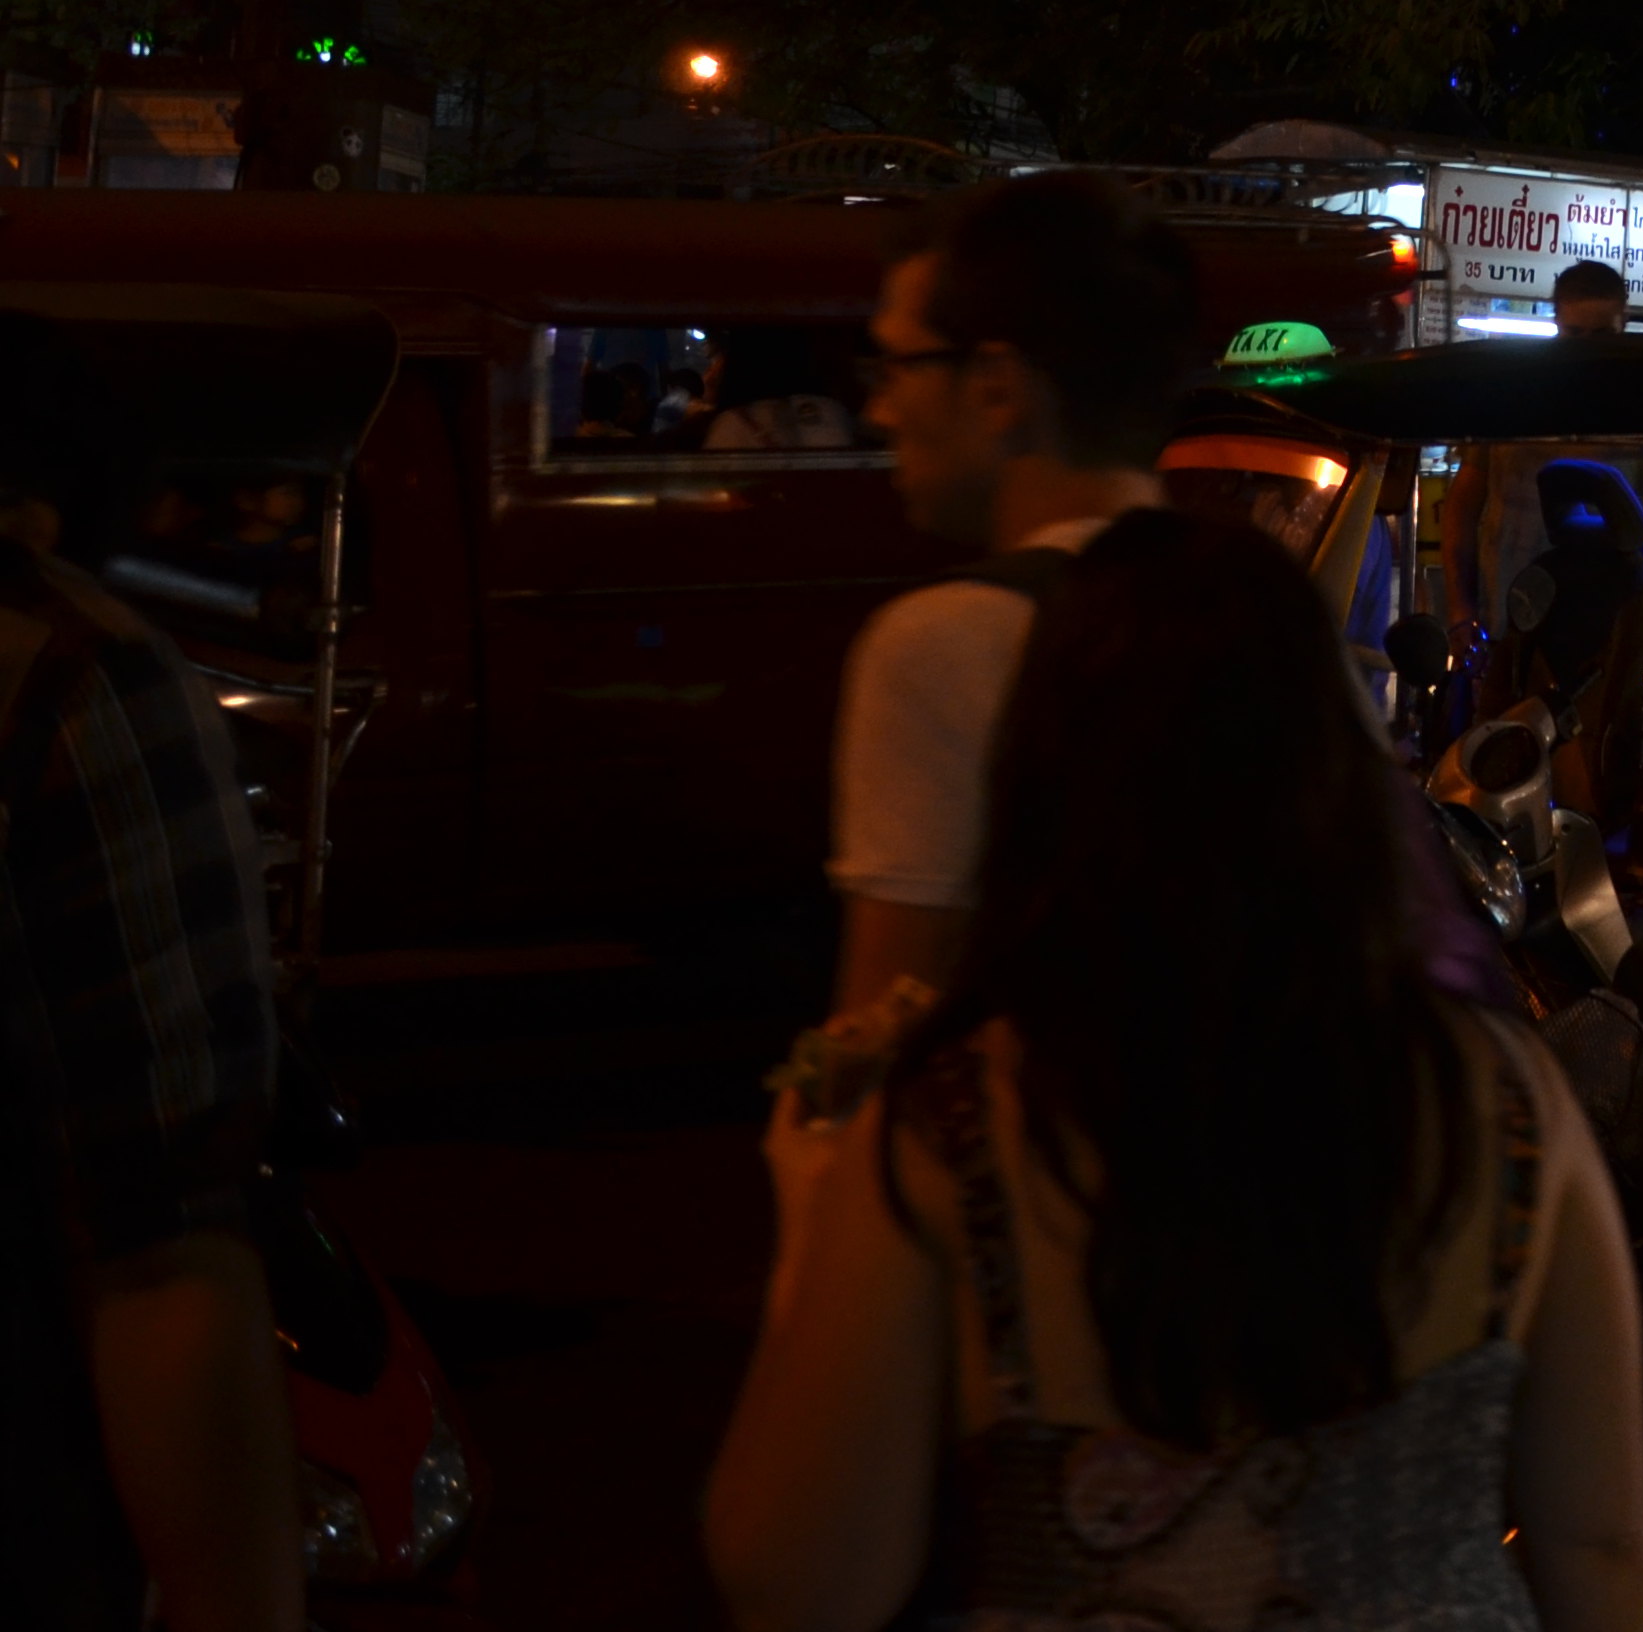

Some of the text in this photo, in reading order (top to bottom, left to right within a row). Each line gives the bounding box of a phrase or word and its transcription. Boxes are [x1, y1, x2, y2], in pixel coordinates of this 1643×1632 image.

[1441, 184, 1560, 253] ก๋วยเตี๋ยว
[1567, 193, 1627, 227] ต้มยำ
[1465, 260, 1535, 283] 35 บาท
[1231, 328, 1289, 353] TAXI
